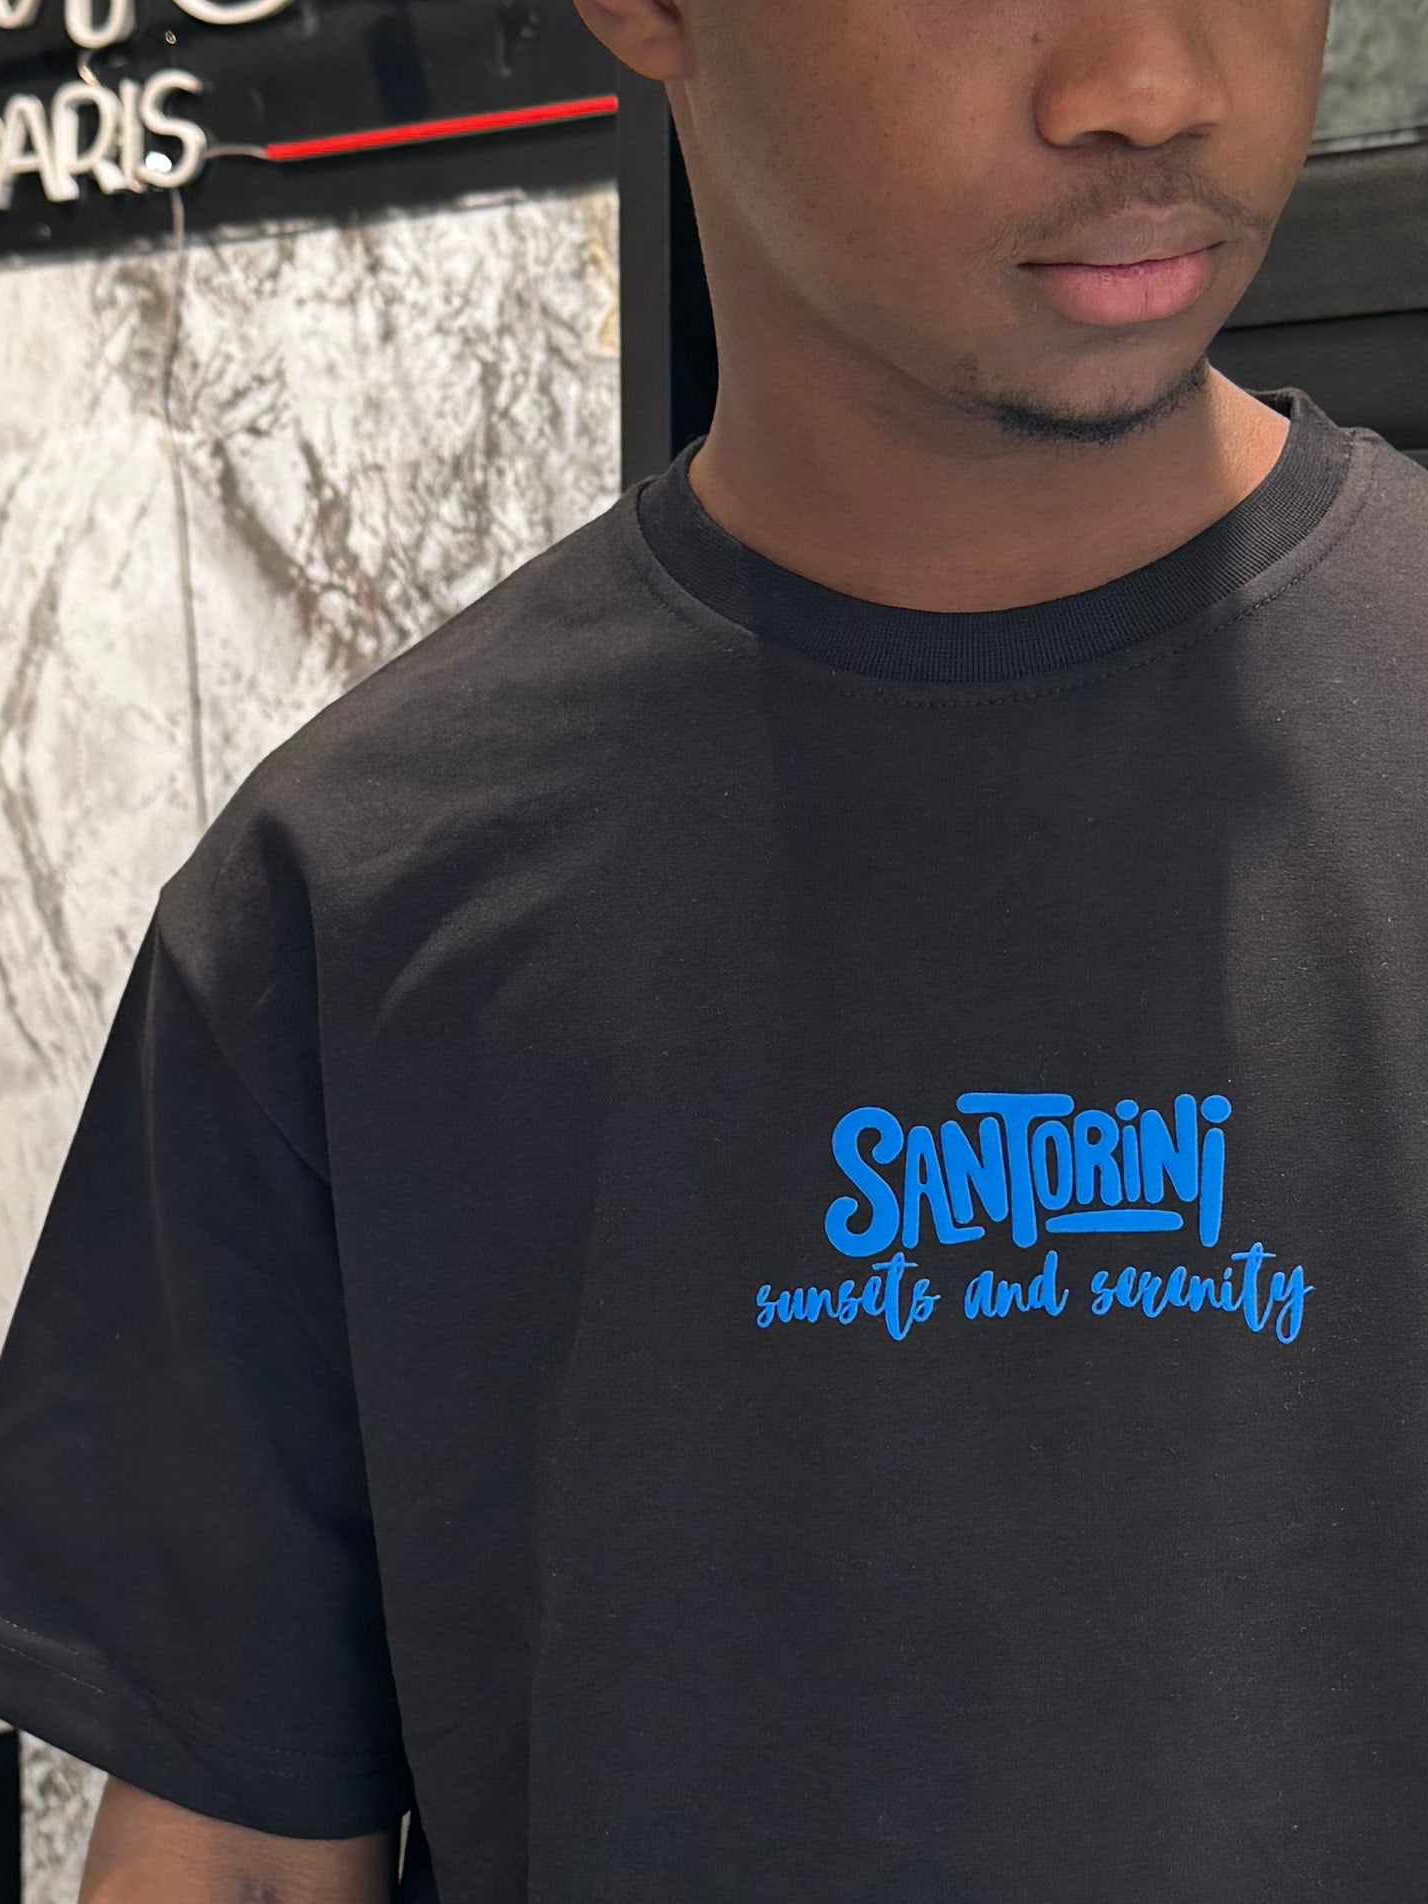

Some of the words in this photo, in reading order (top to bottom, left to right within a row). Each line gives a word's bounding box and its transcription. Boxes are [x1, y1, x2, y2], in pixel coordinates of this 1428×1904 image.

[755, 1252, 941, 1342] sunsets
[964, 1249, 1070, 1319] and
[1090, 1241, 1315, 1345] serenity
